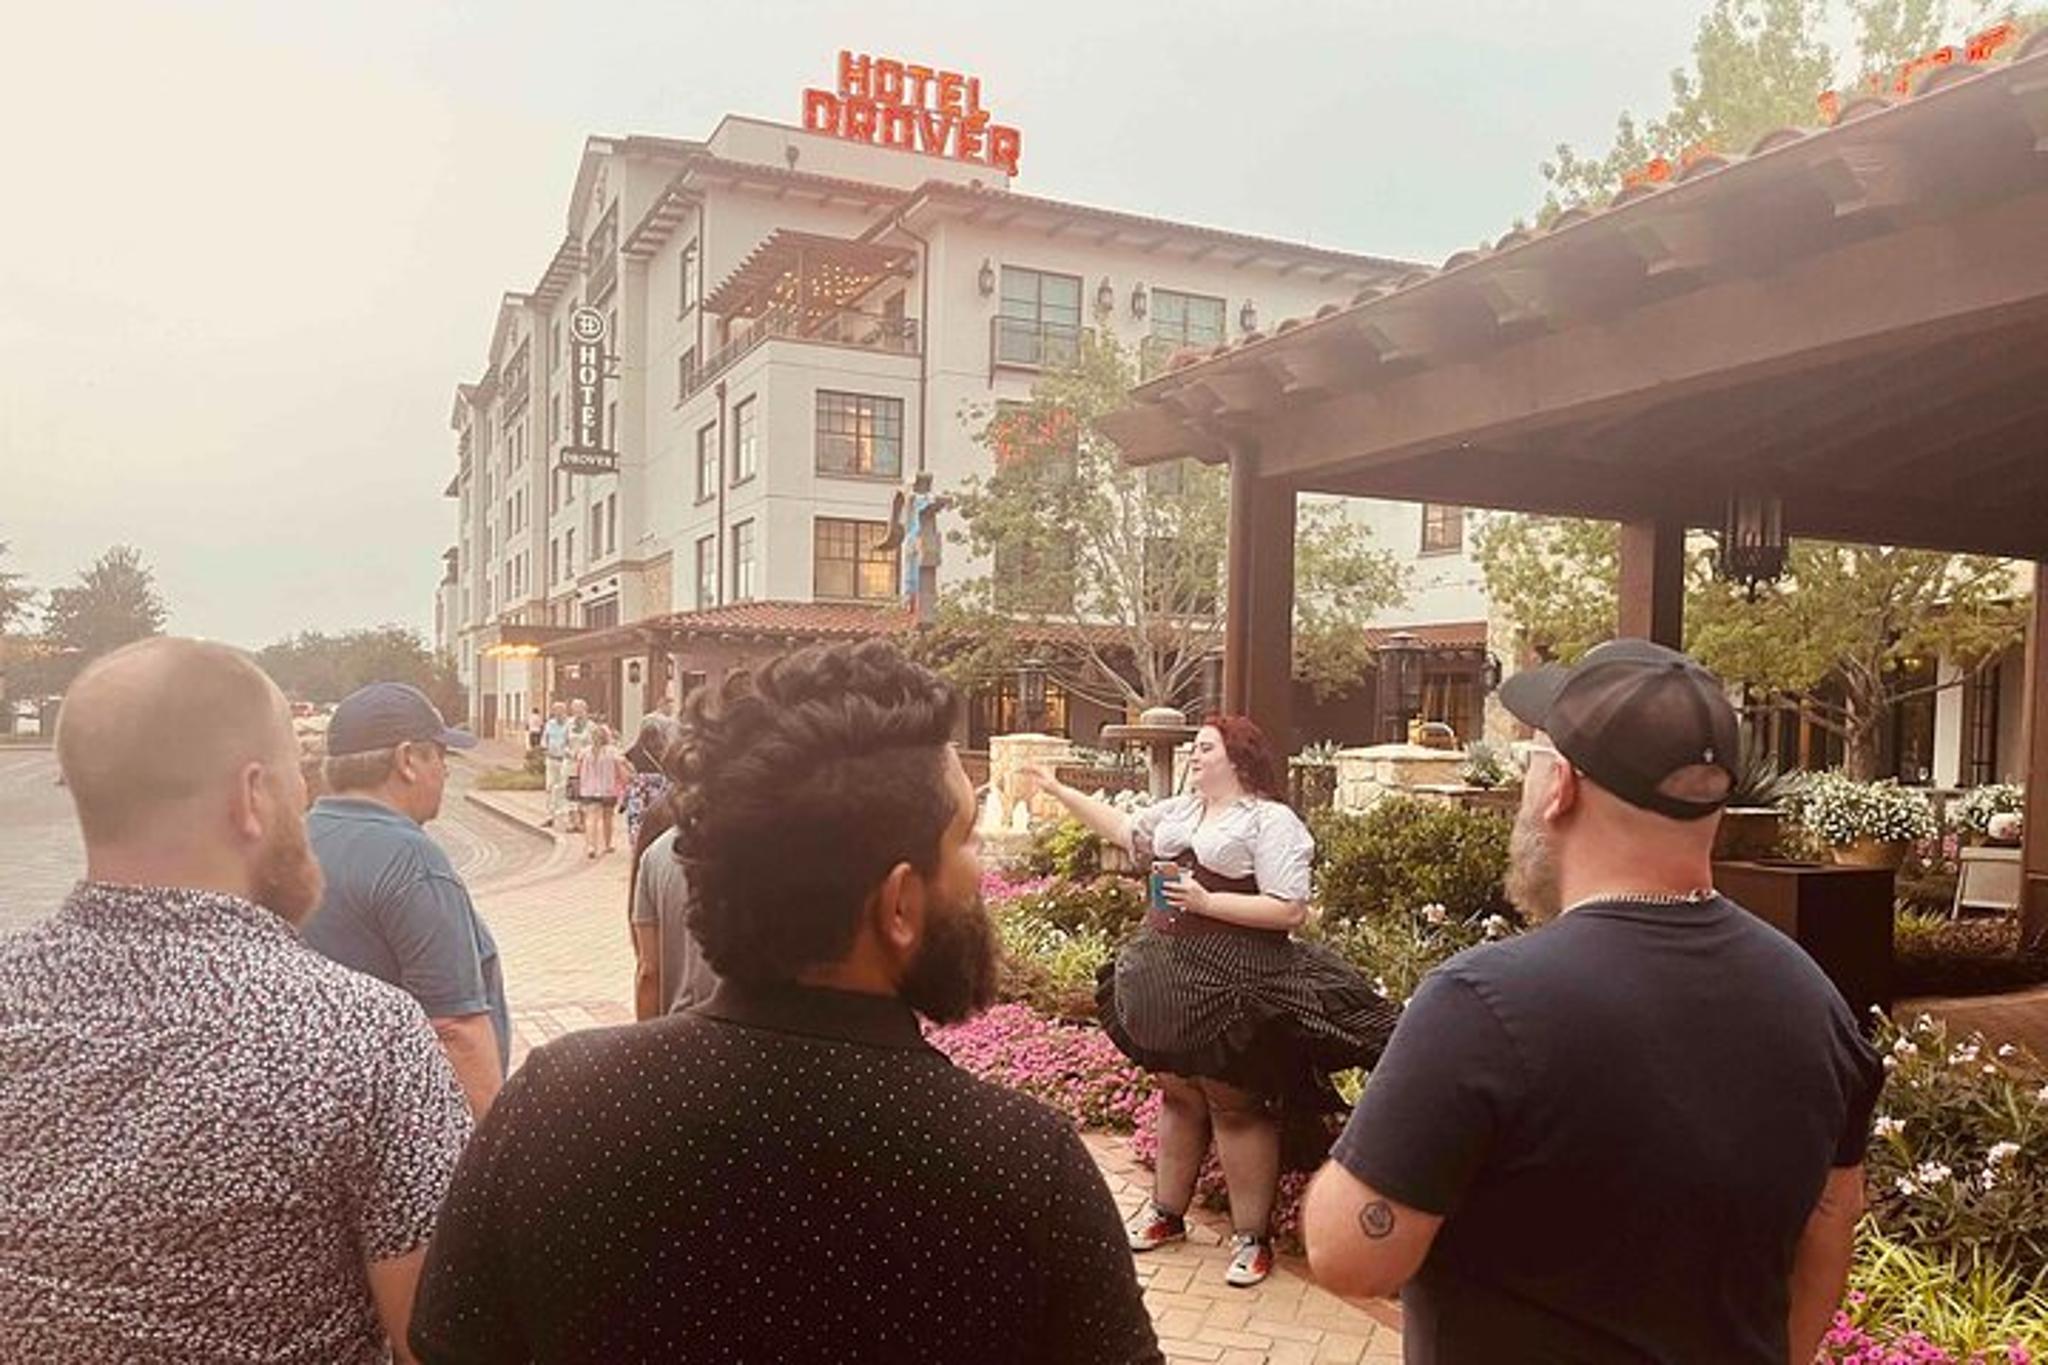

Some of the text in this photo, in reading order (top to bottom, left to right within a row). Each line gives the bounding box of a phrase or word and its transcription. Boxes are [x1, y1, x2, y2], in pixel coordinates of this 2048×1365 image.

[803, 88, 1021, 177] DROVER
[839, 50, 990, 128] HOTEL
[579, 345, 597, 447] HOTEL
